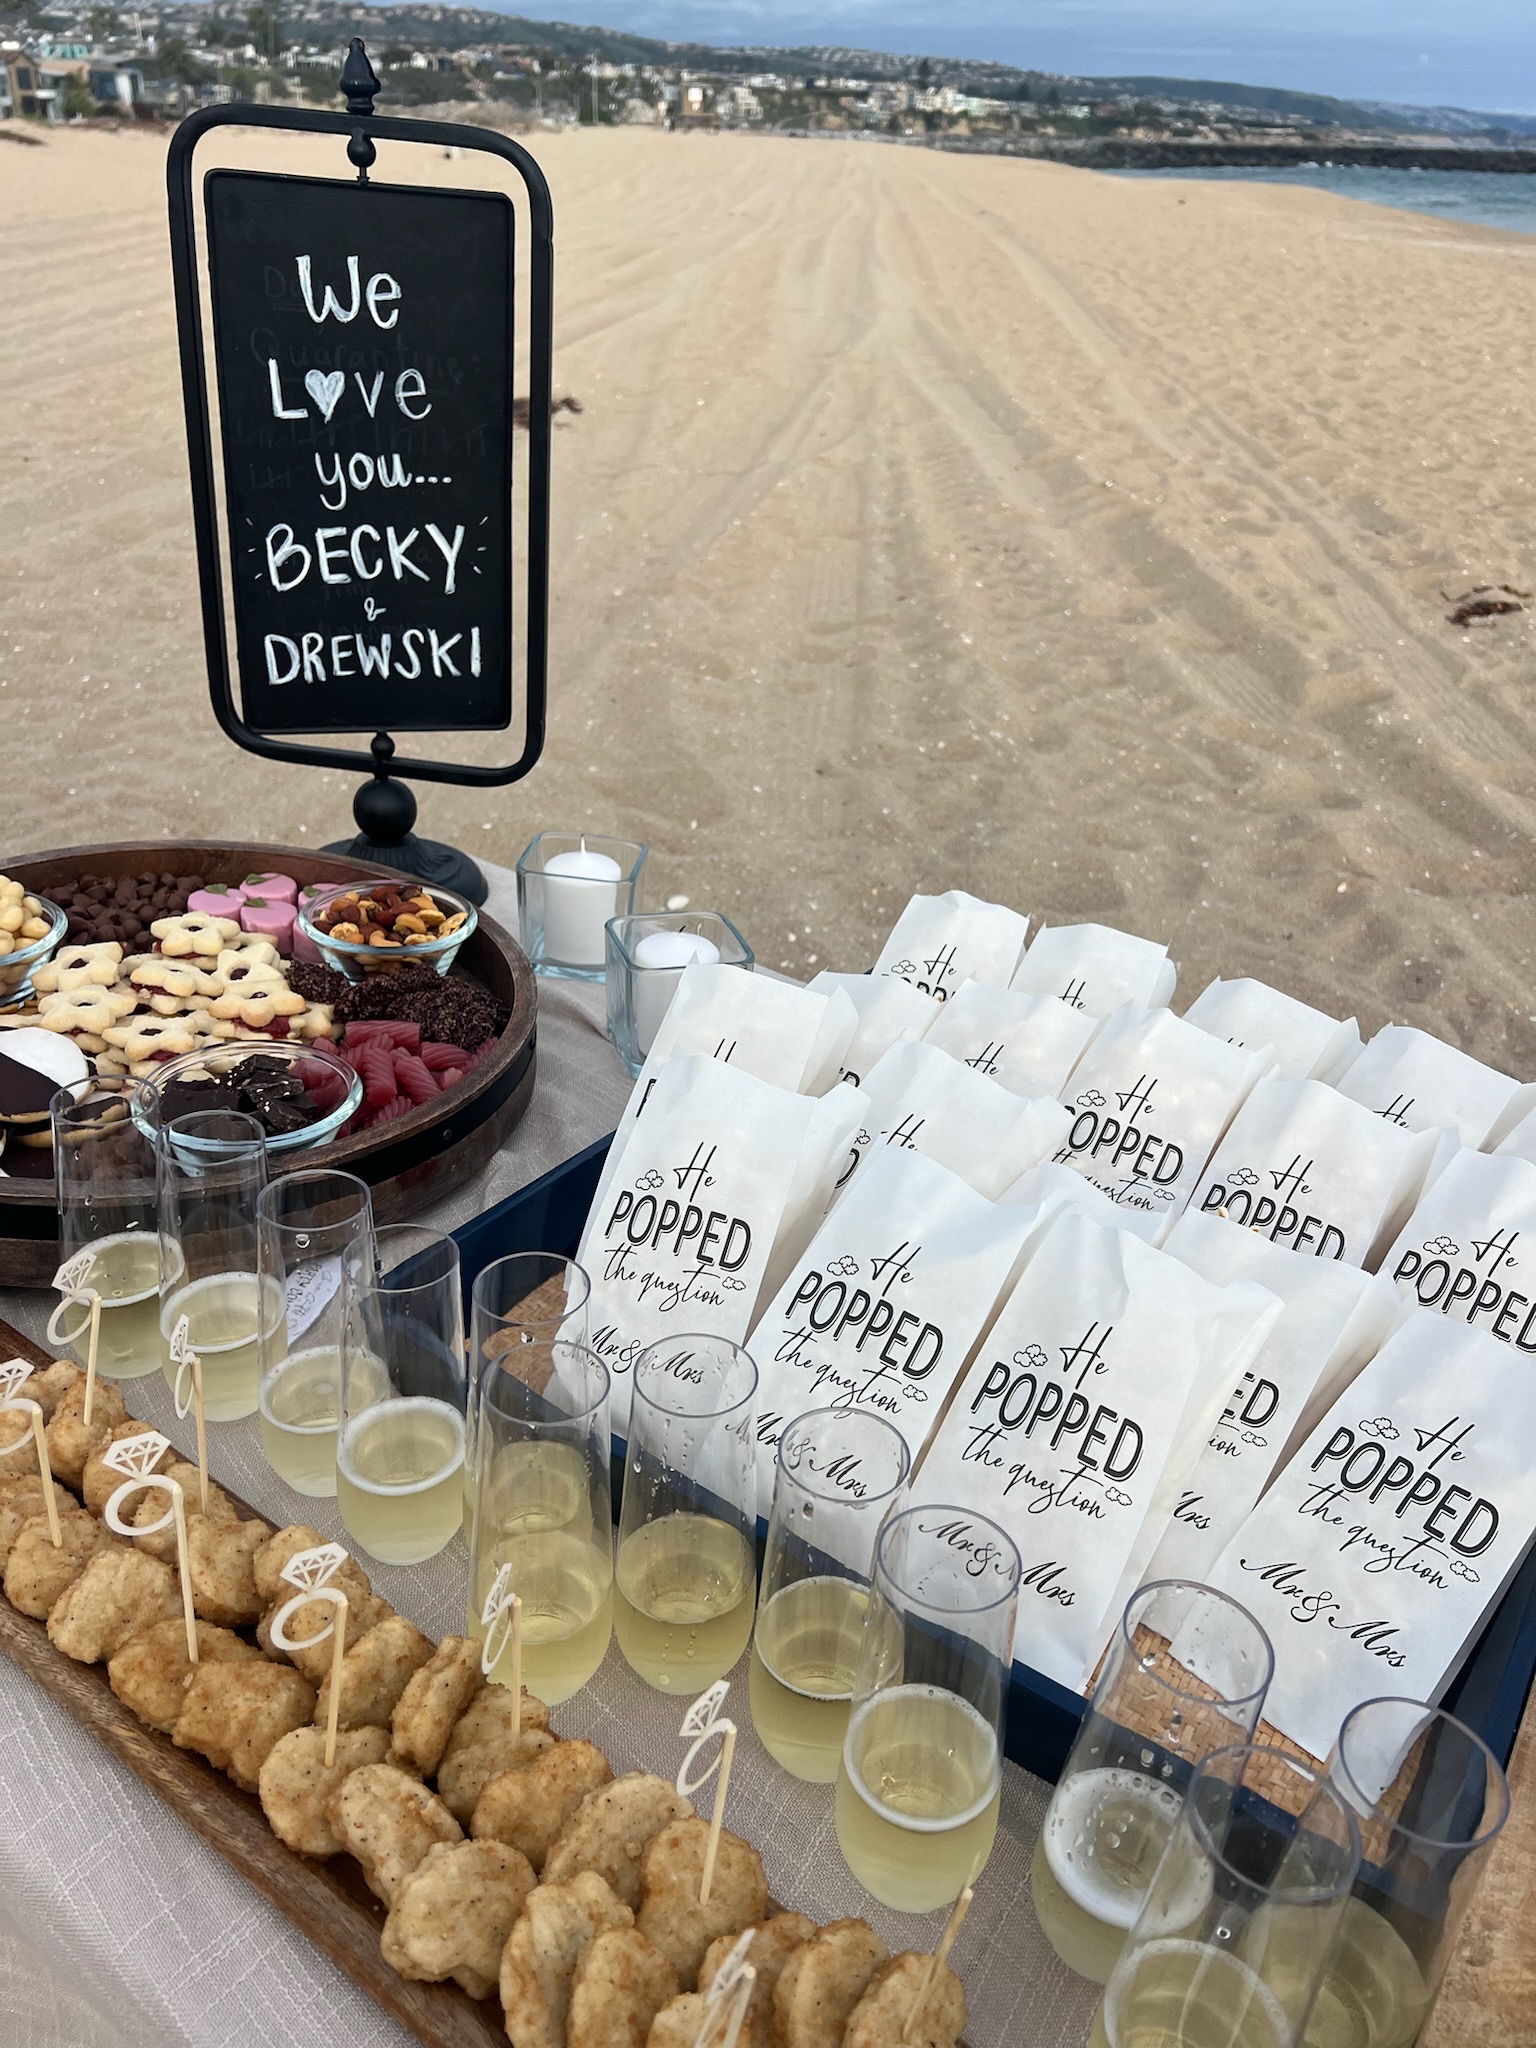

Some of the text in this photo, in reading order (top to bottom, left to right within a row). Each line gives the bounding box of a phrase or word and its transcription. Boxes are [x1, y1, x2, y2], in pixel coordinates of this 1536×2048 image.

[296, 254, 402, 329] We
[265, 522, 465, 595] BECKY
[264, 626, 481, 686] DREWSKI
[923, 944, 957, 985] He
[1115, 1074, 1158, 1124] He
[673, 1142, 717, 1202] He
[1064, 1105, 1184, 1186] OPPED
[1269, 1154, 1314, 1204] He
[604, 1190, 752, 1272] POPPED
[1470, 1228, 1519, 1278] He
[604, 1242, 725, 1312] the question
[870, 1241, 922, 1297] He
[785, 1270, 943, 1381] POPPED
[1059, 1321, 1113, 1390] He
[774, 1326, 902, 1418] the question
[970, 1361, 1144, 1483] POPPED
[1413, 1416, 1476, 1470] He
[961, 1423, 1106, 1519] the question
[1311, 1426, 1499, 1558] POPPED
[1298, 1482, 1449, 1589] the question
[1240, 1558, 1408, 1667] Mr & Mrs
